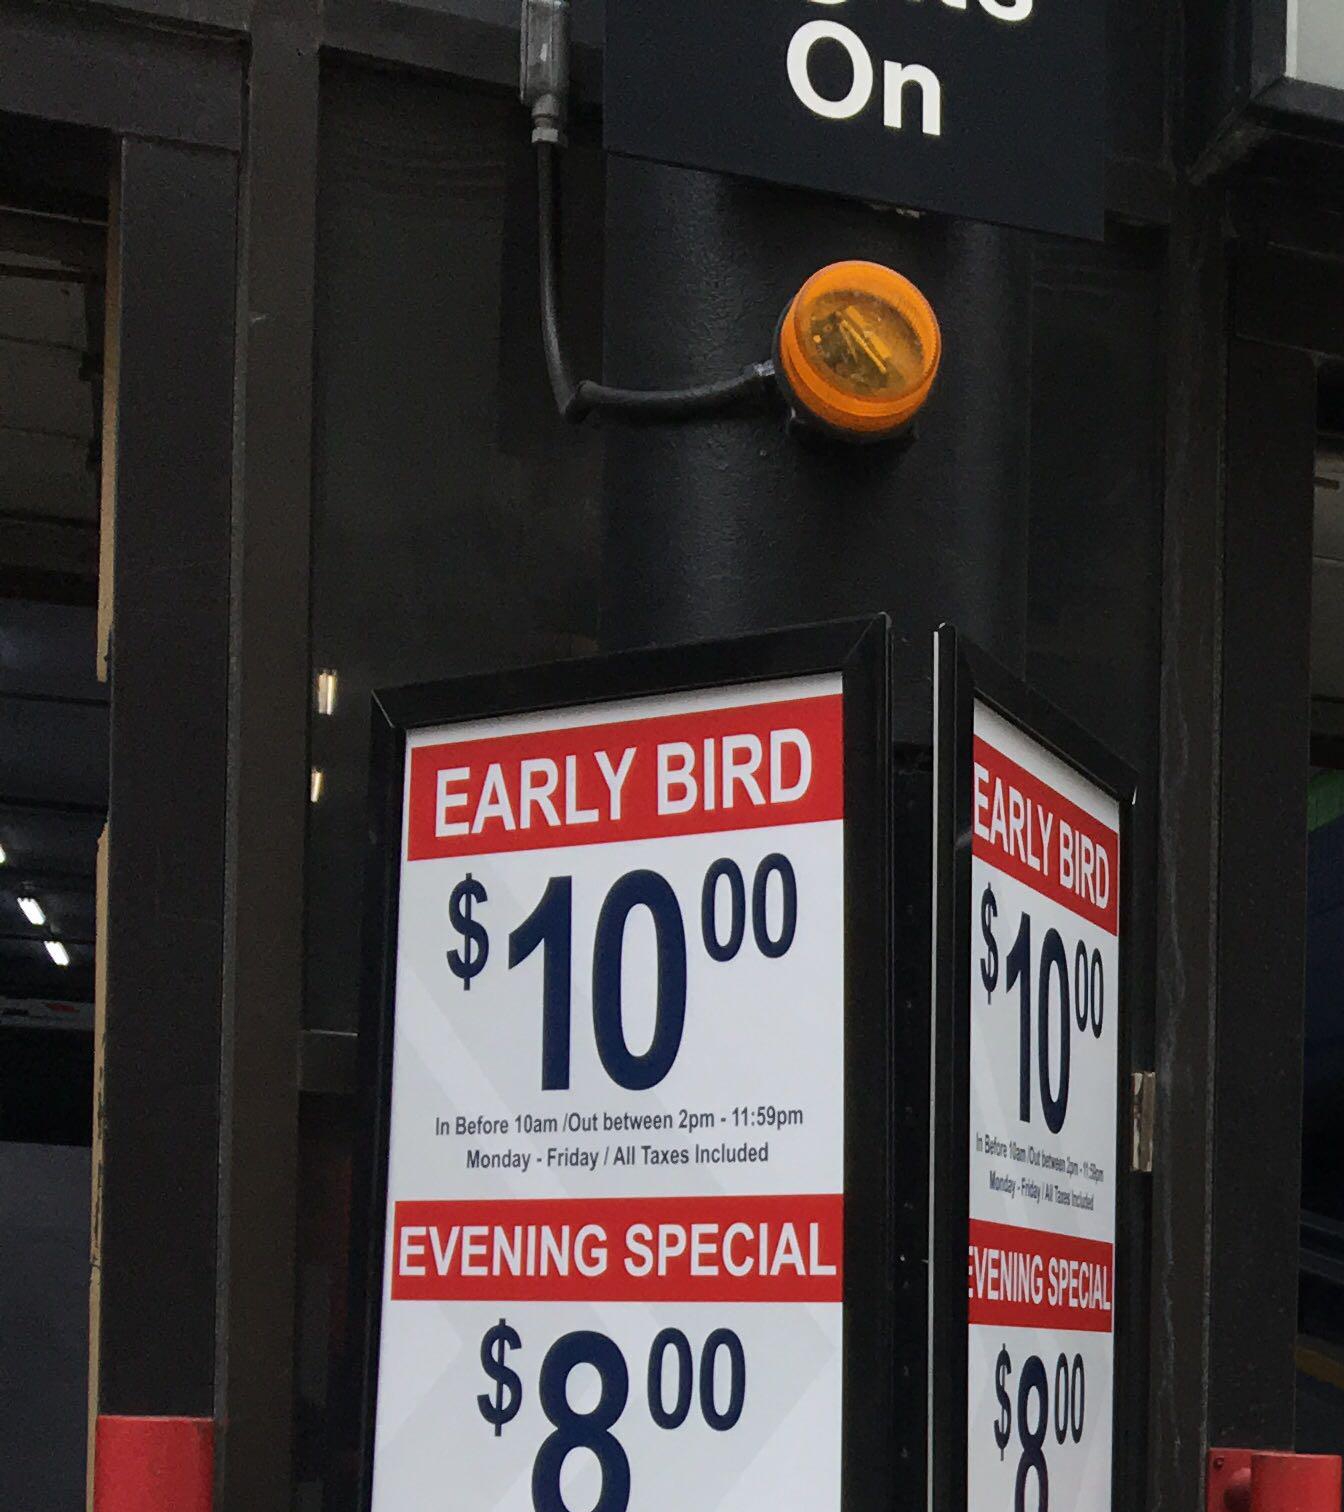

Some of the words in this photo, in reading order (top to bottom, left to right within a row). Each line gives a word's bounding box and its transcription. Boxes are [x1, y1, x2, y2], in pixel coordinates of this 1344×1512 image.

[786, 19, 942, 136] On
[434, 746, 638, 838] EARLY
[656, 727, 813, 817] BIRD
[974, 762, 1054, 876] EARLY
[1059, 819, 1110, 910] BIRD
[435, 1117, 450, 1136] In
[455, 1115, 509, 1135] Before
[515, 1114, 558, 1133] 10am
[603, 1111, 673, 1131] between
[679, 1109, 715, 1133] 2pm
[732, 1105, 804, 1131] 11:59pm
[466, 1149, 531, 1173] Monday
[547, 1147, 600, 1171] Friday
[613, 1146, 636, 1166] All
[641, 1145, 690, 1165] Taxes
[695, 1142, 769, 1164] Included
[399, 1224, 608, 1279] EVENING
[623, 1222, 838, 1278] SPECIAL
[1048, 1256, 1111, 1311] SPECIAL
